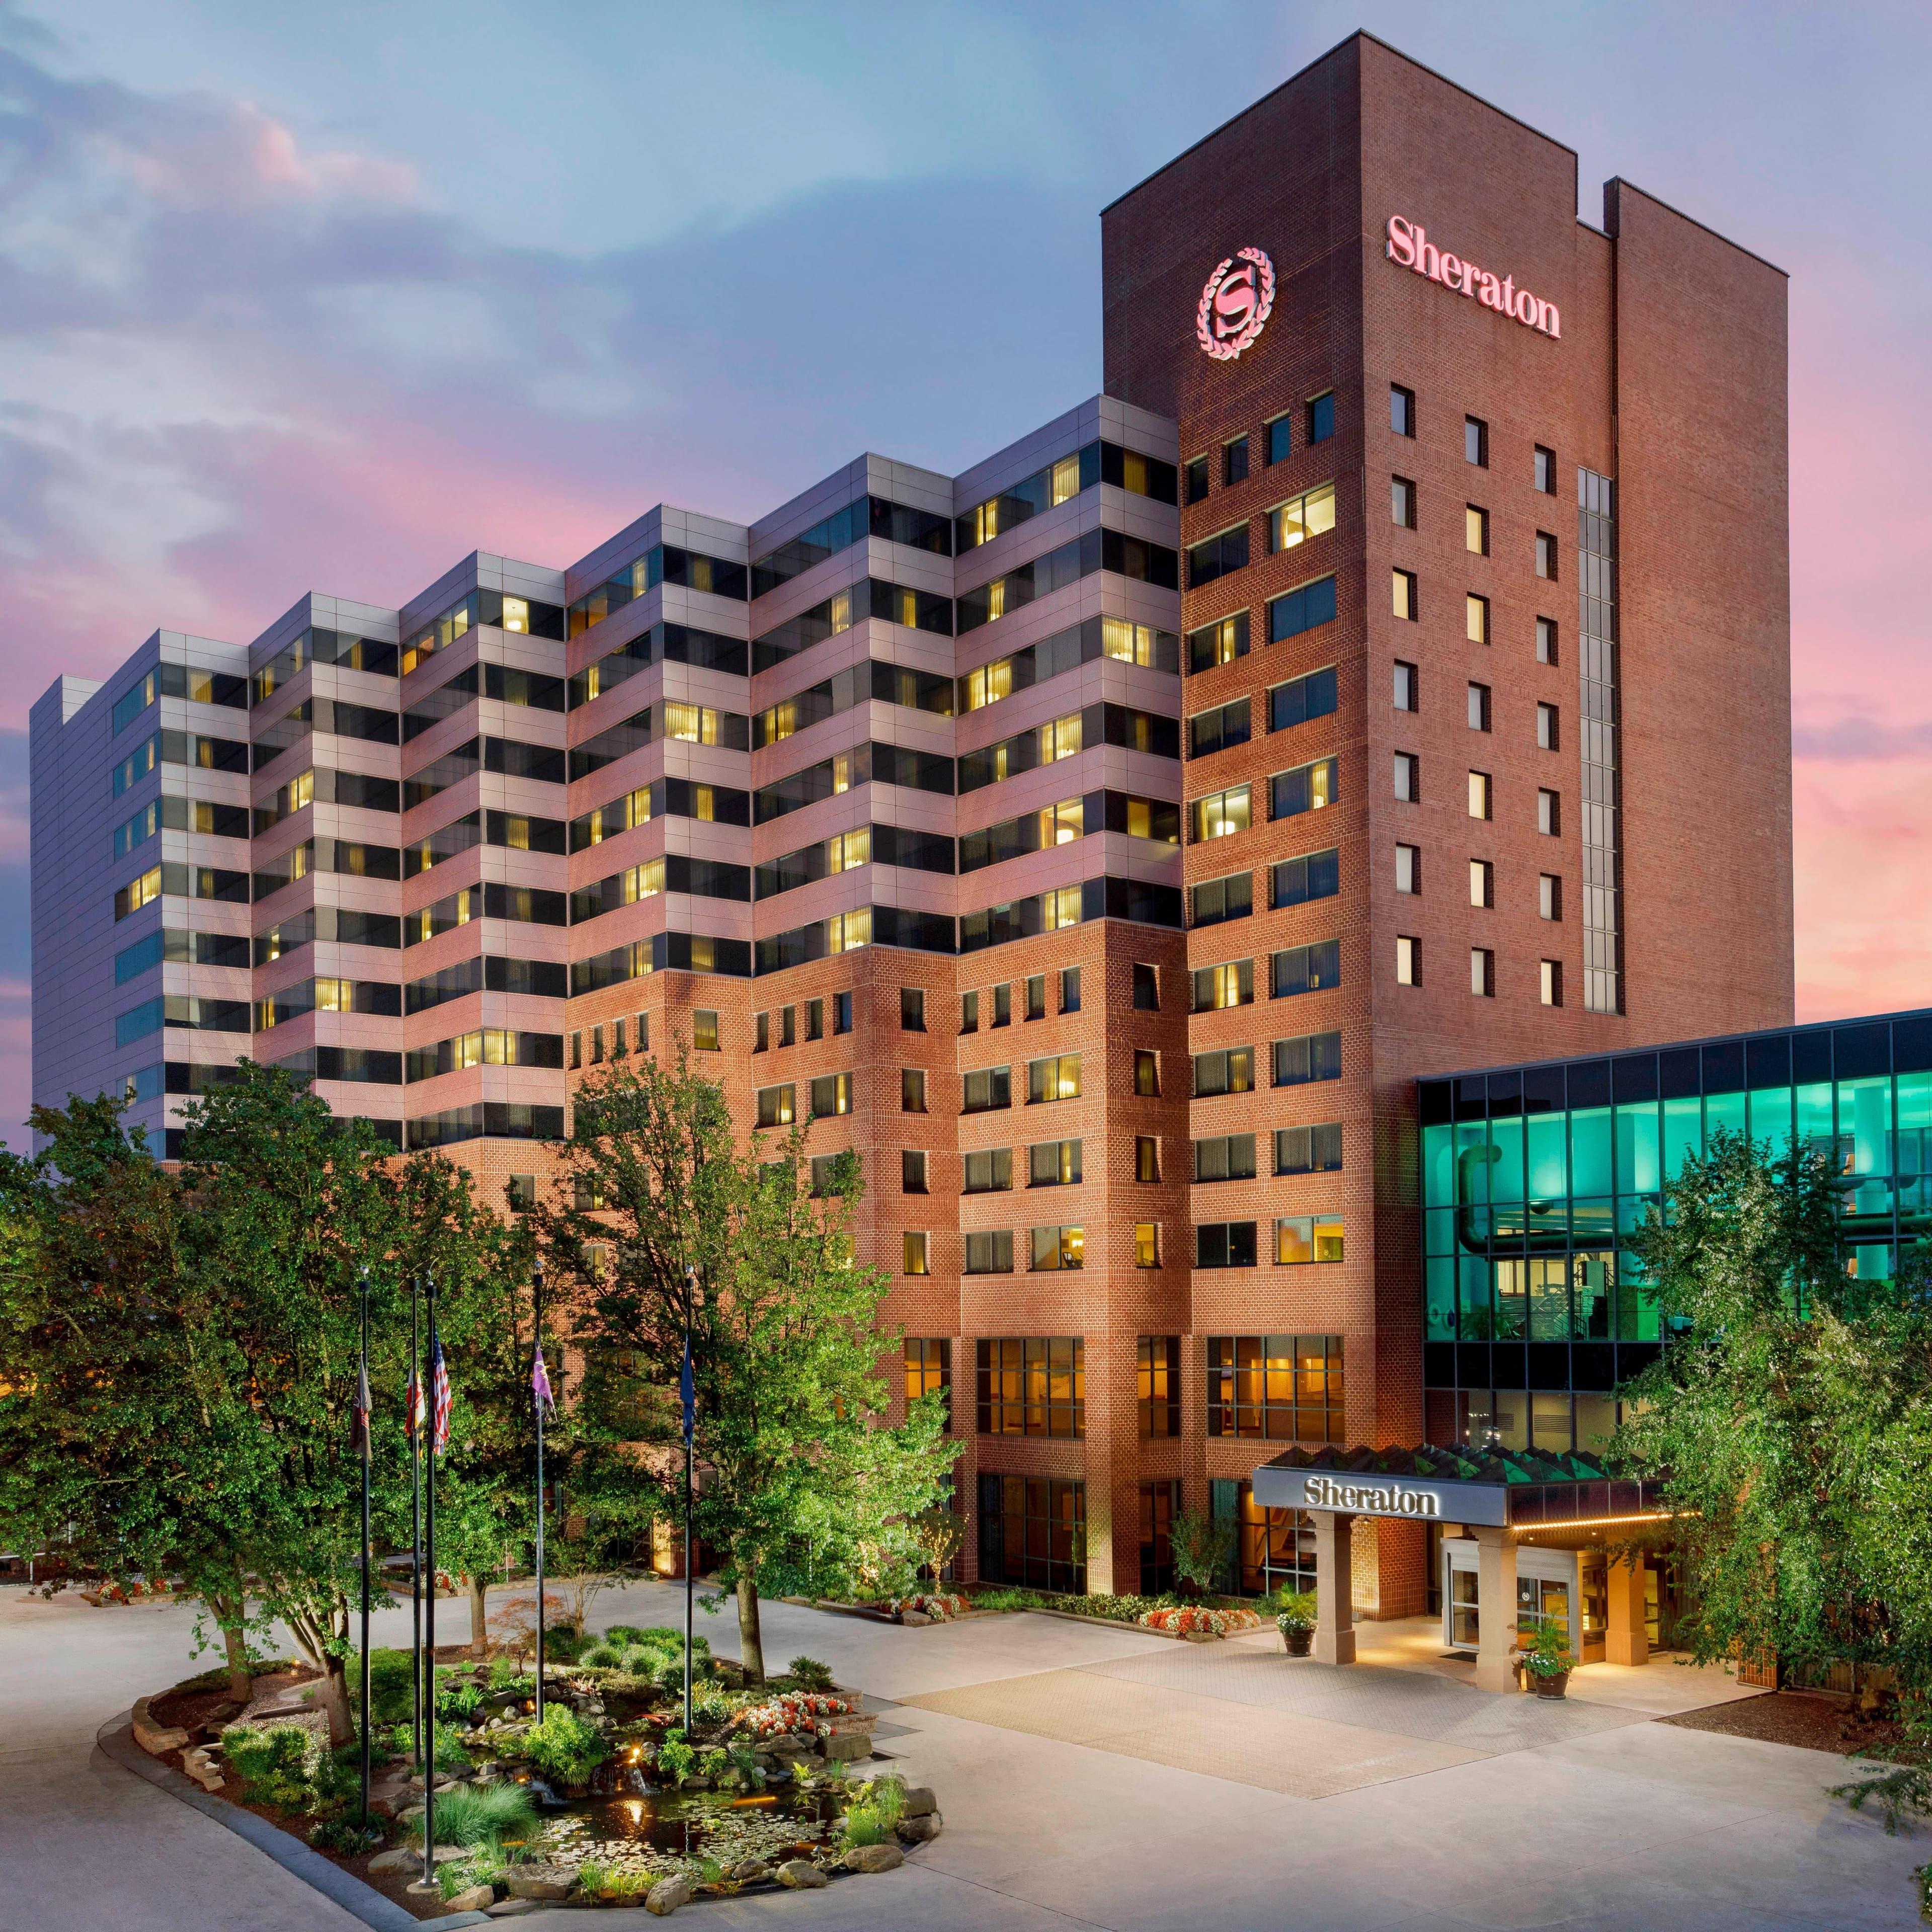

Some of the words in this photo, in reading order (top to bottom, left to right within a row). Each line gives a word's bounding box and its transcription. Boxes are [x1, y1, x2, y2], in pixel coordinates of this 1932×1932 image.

[1216, 266, 1258, 338] S
[1386, 215, 1561, 340] Sheraton
[1304, 1477, 1438, 1515] Sheraton
